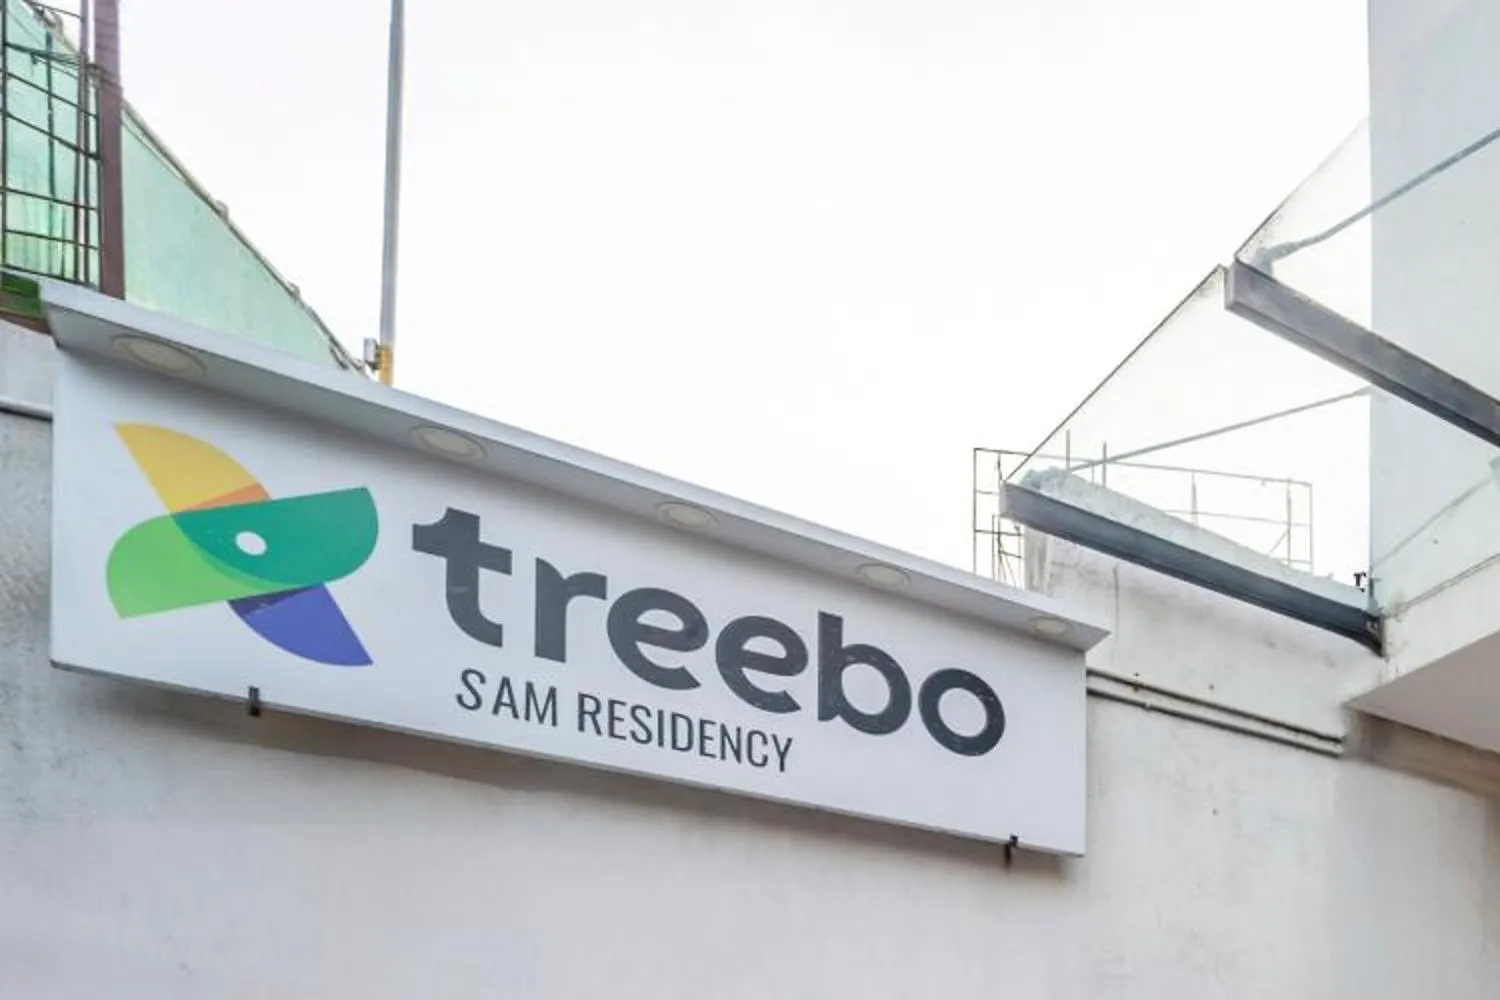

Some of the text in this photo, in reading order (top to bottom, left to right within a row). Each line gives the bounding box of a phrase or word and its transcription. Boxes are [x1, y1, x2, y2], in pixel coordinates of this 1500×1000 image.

[412, 507, 1006, 757] treebo
[455, 668, 795, 773] SAM RESIDENCY
